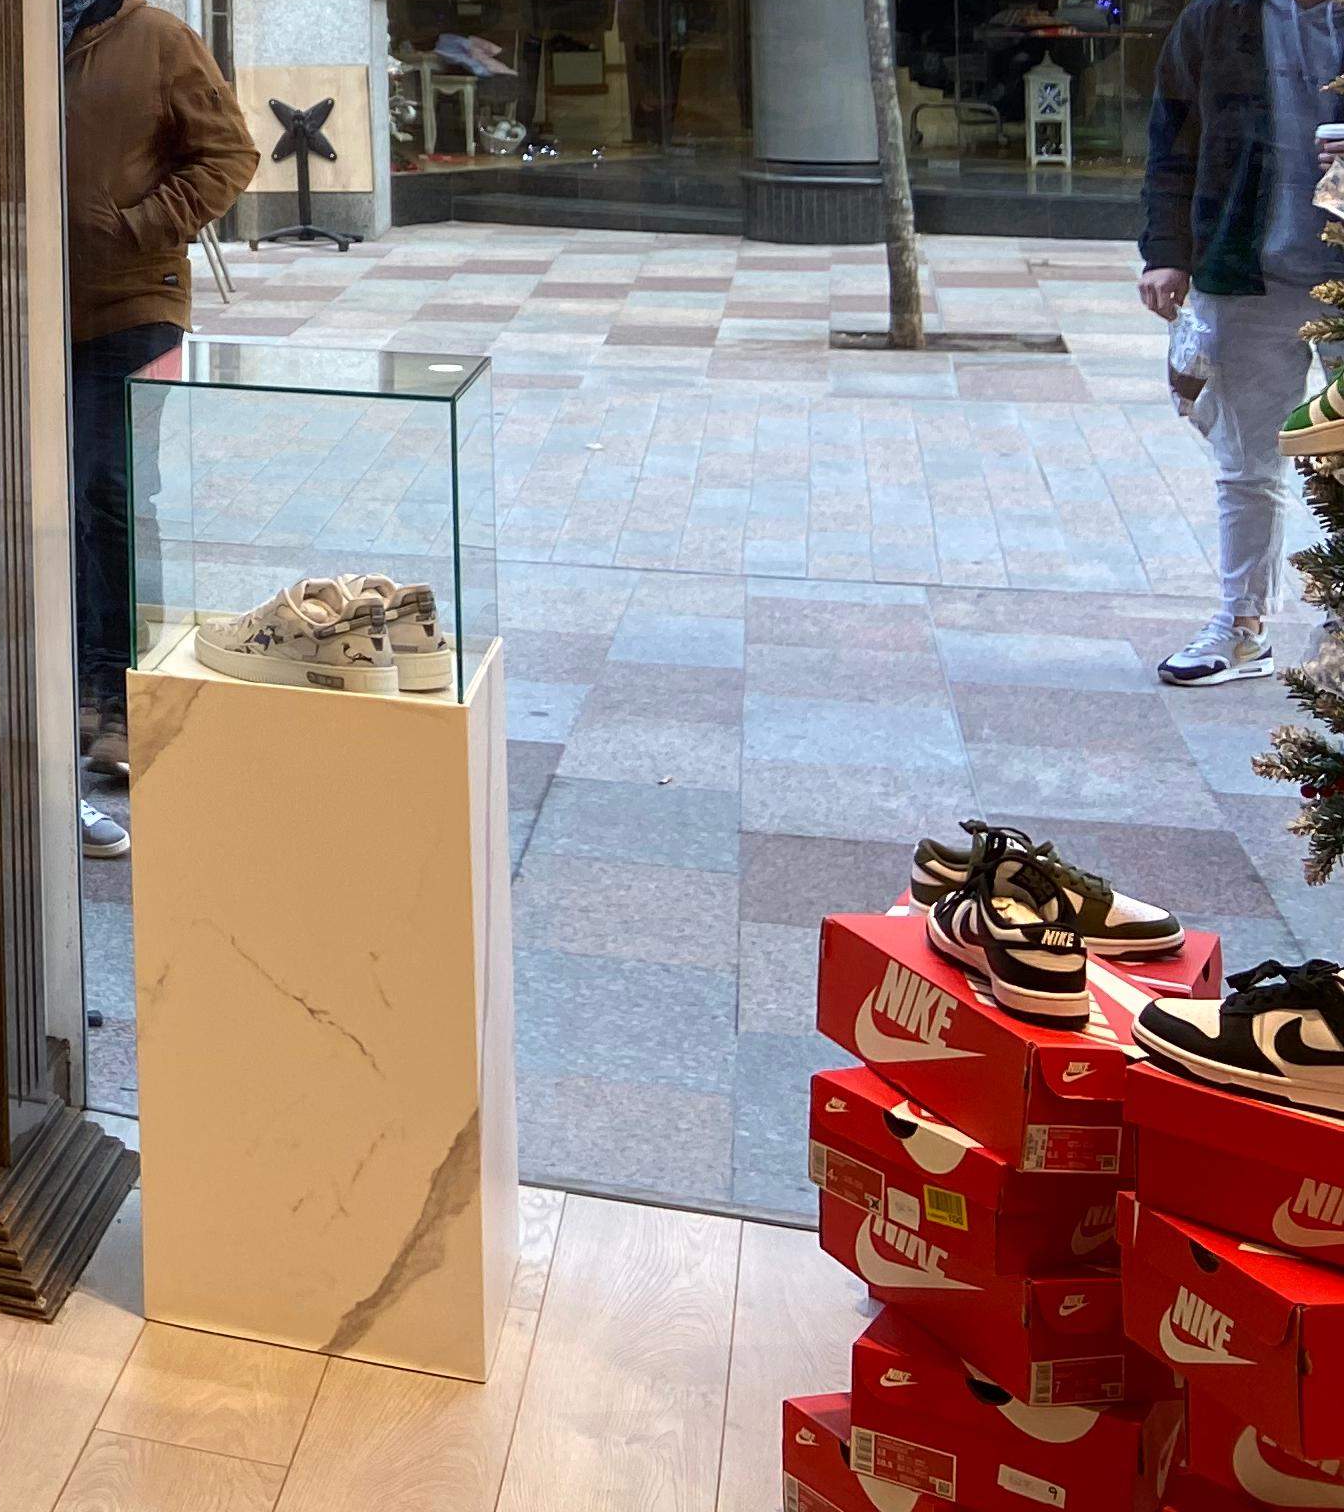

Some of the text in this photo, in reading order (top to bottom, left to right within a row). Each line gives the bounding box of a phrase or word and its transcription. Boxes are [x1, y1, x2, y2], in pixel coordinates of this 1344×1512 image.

[1041, 928, 1075, 948] NIKE
[874, 958, 959, 1048] NIKE
[1172, 1285, 1235, 1356] NIKE
[886, 1368, 913, 1384] NIKE
[1048, 1486, 1058, 1500] 9
